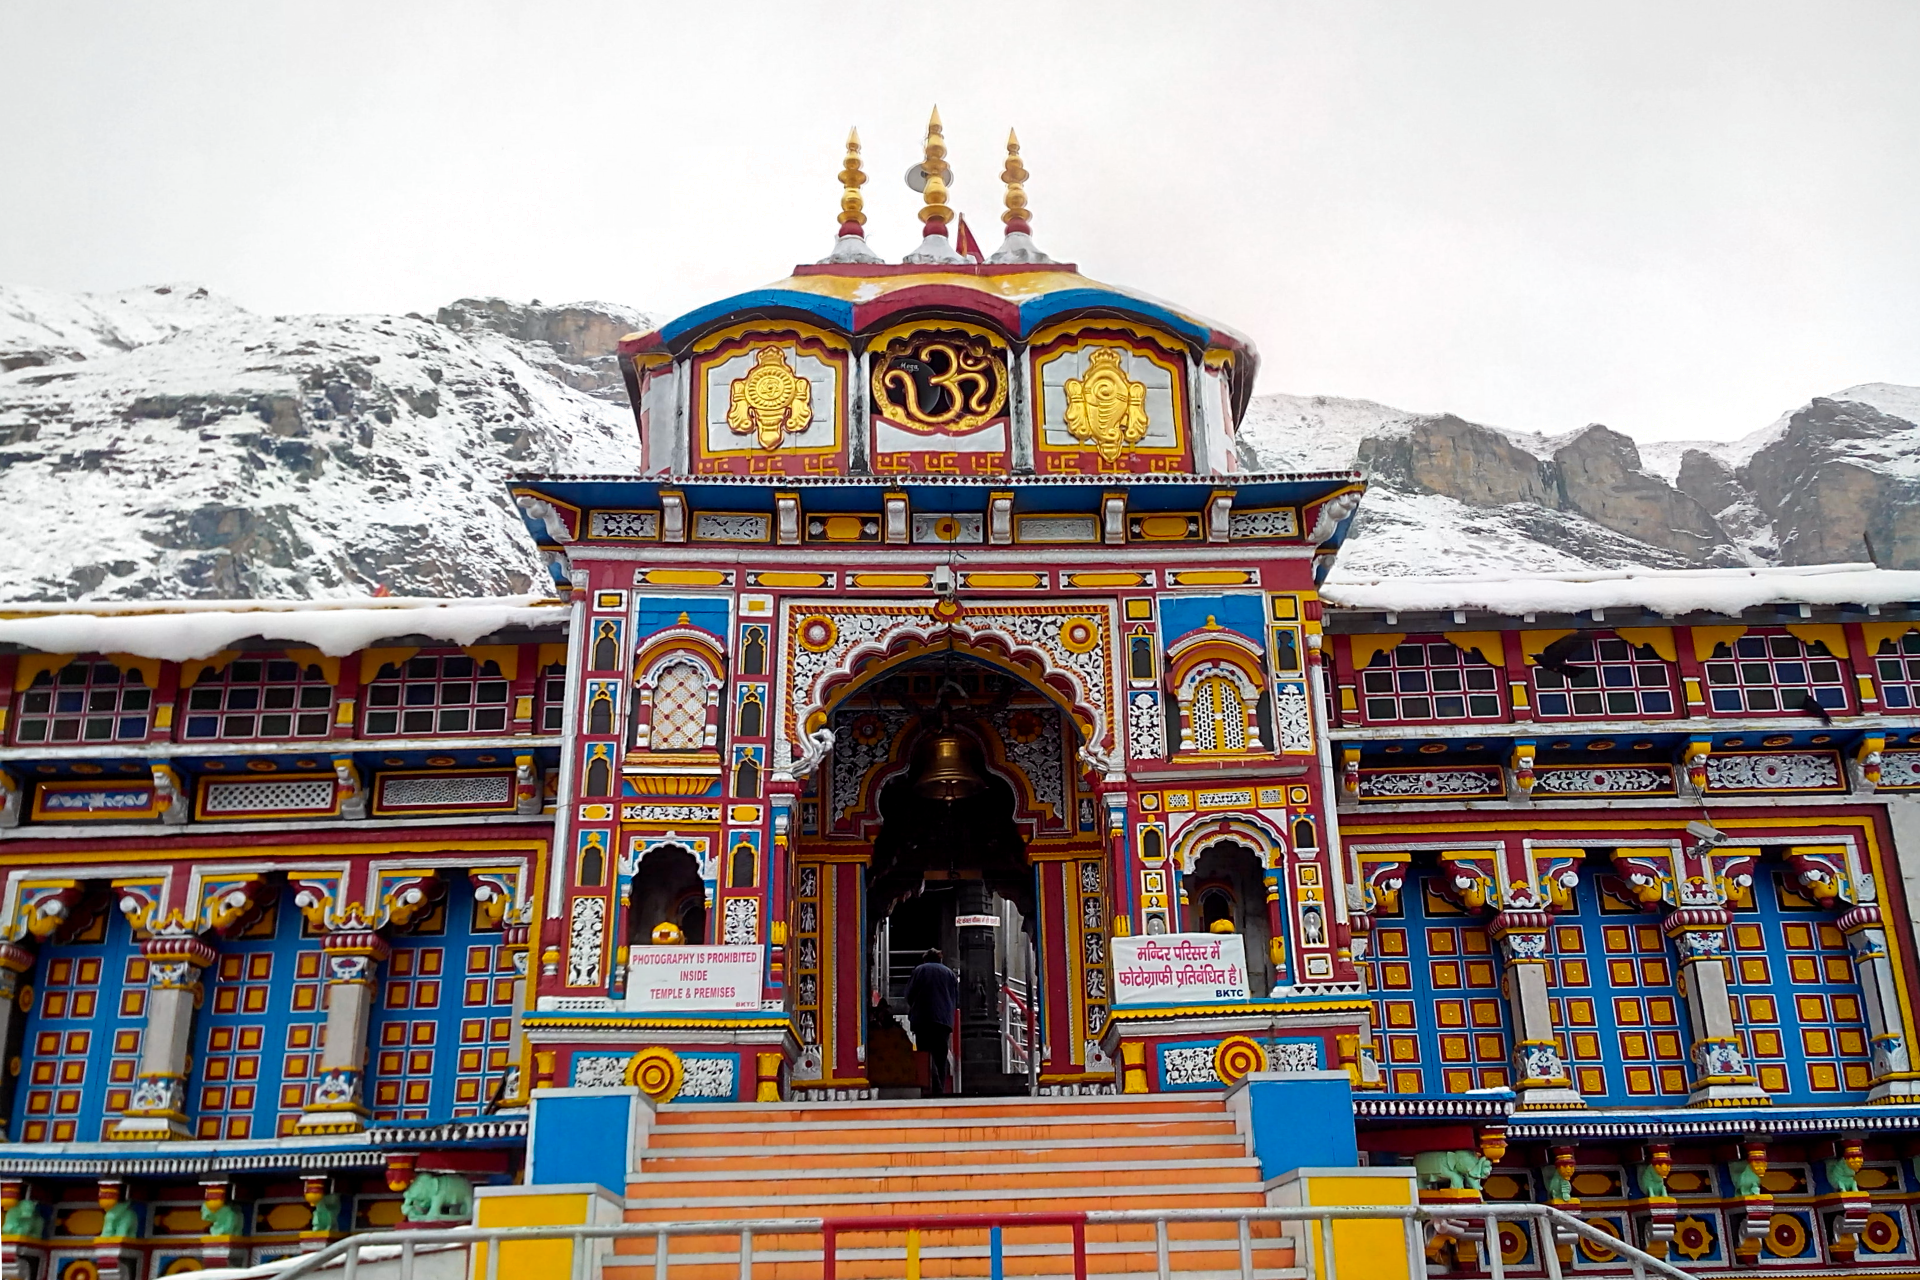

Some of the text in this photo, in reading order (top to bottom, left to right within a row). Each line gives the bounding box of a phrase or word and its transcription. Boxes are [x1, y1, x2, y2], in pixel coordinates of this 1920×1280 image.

[1137, 940, 1221, 960] मन्दिर परिसर में
[632, 952, 757, 965] PHOTOGRAPHY IS PROHIBITED
[680, 970, 708, 981] INSIDE
[1119, 965, 1172, 988] फोटोग्राफी
[1175, 964, 1225, 988] प्रतिबंधित
[650, 987, 735, 999] TEMPLE & PREMISES
